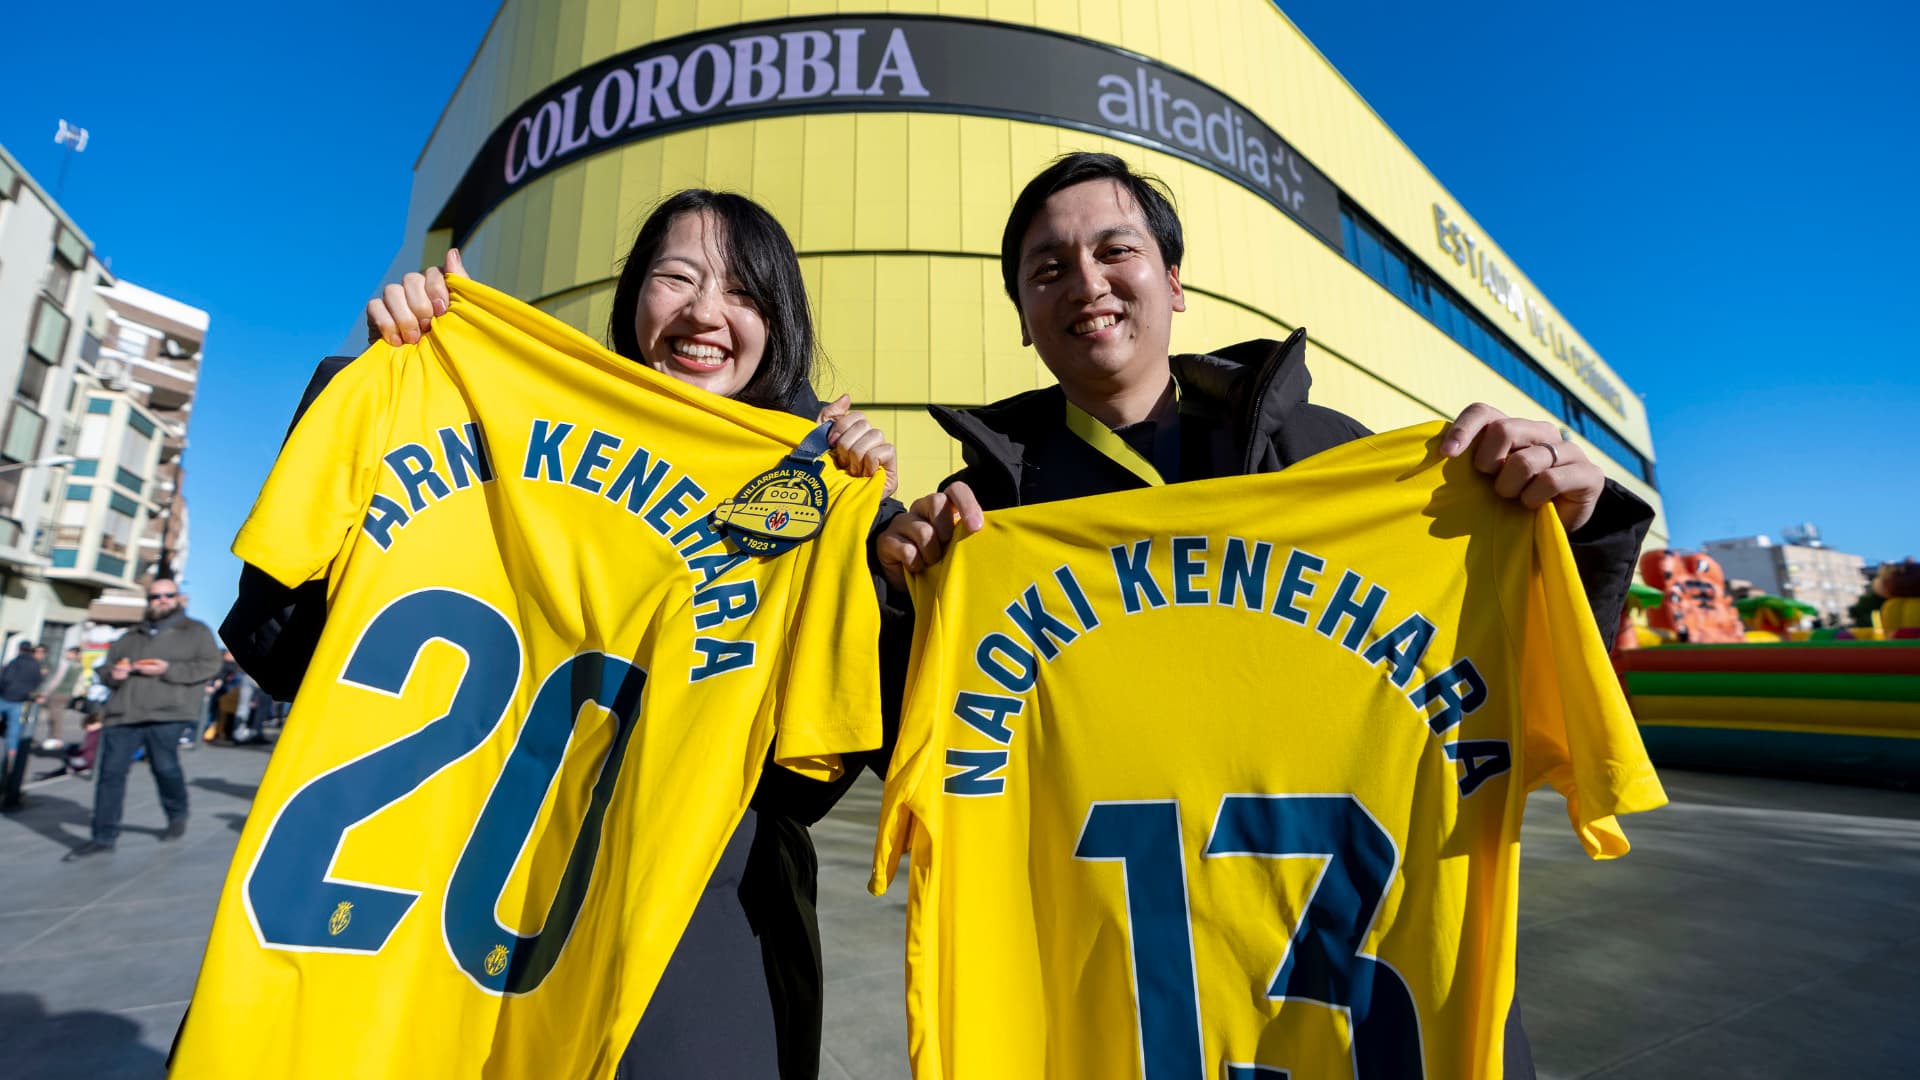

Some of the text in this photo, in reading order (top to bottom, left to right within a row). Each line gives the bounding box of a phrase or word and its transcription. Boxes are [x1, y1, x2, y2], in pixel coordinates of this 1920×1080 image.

[504, 28, 930, 184] COLOROBBIA
[1097, 67, 1272, 189] altadia
[1432, 202, 1526, 322] ESTA
[521, 418, 760, 685] KENEHARA
[741, 469, 825, 507] VILLARREAL YELLOW CUP
[746, 538, 769, 551] 1923
[943, 535, 1513, 800] NAOKI KENEHARA
[242, 586, 650, 999] 20
[1073, 793, 1427, 1080] 13
